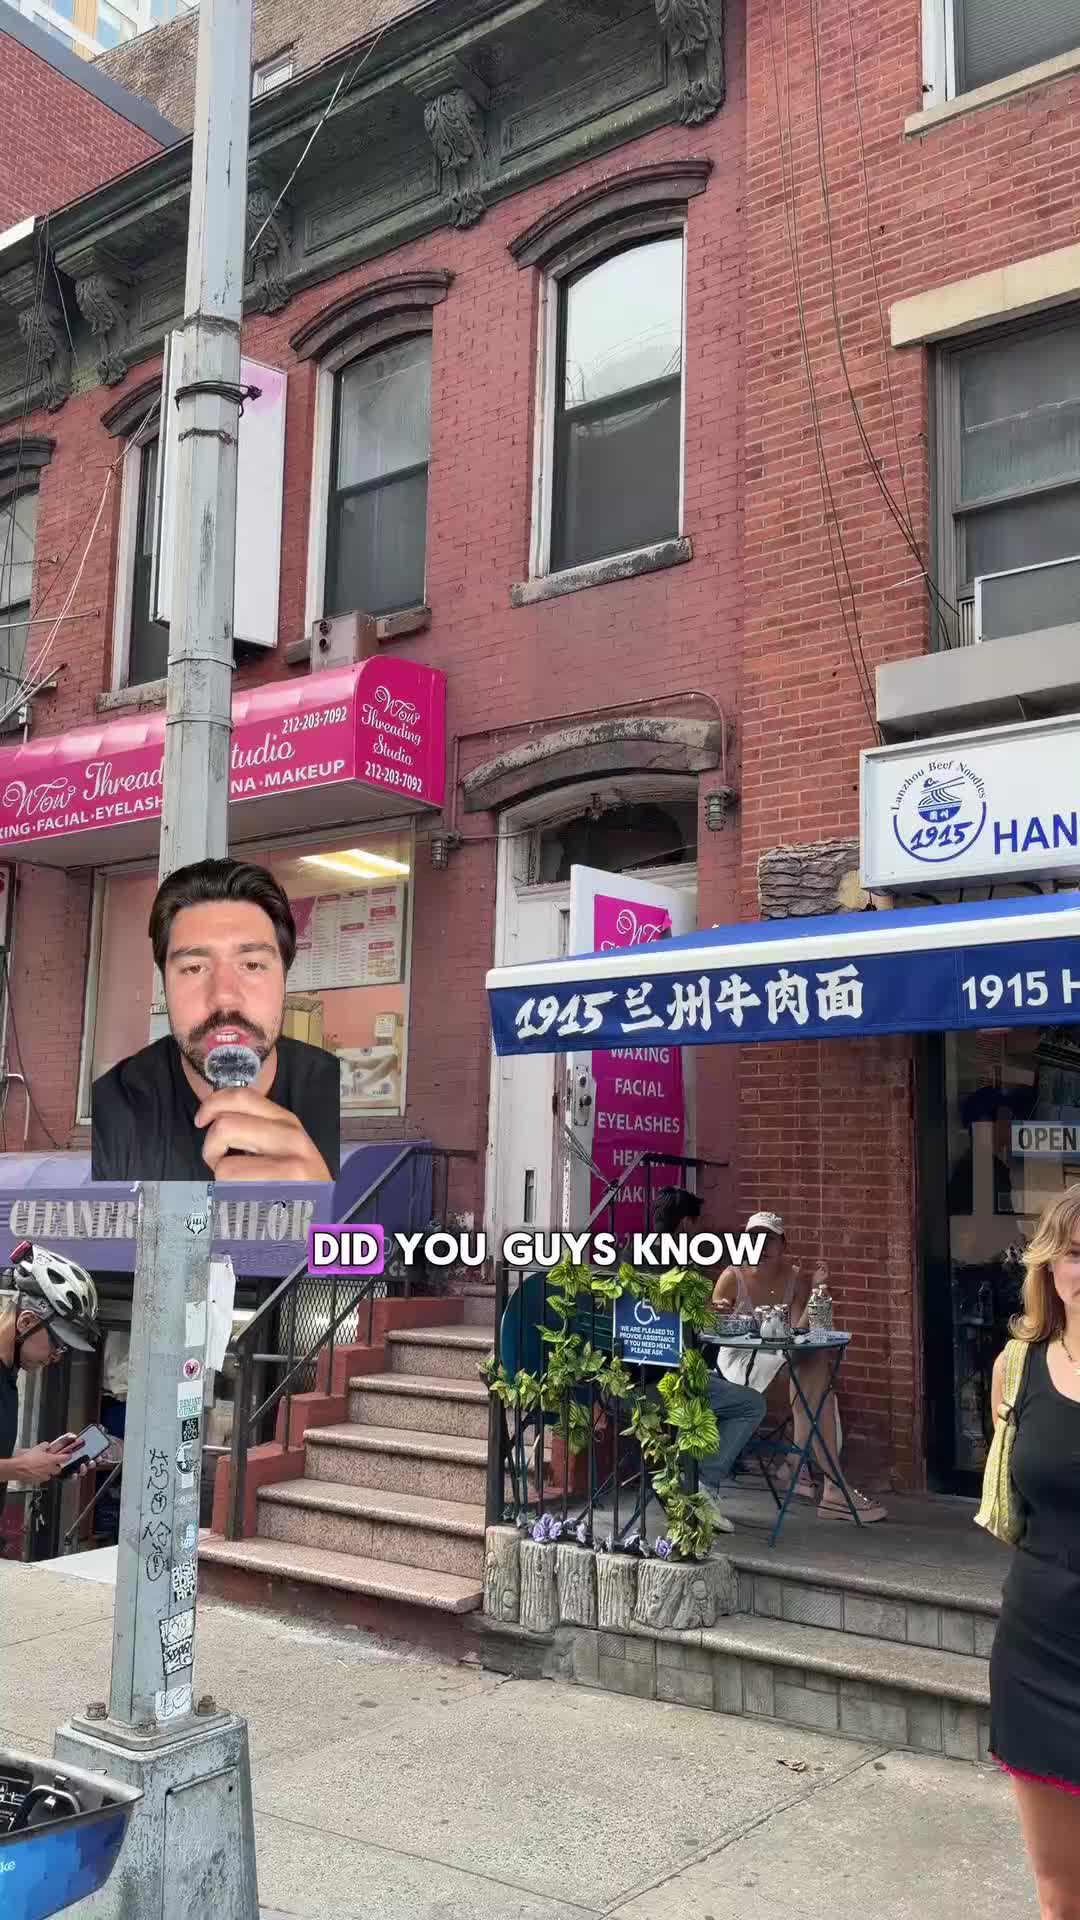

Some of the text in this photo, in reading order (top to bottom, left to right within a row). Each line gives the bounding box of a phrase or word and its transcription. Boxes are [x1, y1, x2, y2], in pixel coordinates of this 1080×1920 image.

[282, 705, 347, 734] 212-203-7092
[375, 686, 420, 725] Wow
[361, 704, 422, 746] Threading
[373, 734, 414, 766] Studio
[3, 732, 296, 818] Wow Thread tudio
[365, 761, 422, 792] 212-203-7092
[891, 760, 986, 811] Lanzhou Beef Noodles
[910, 821, 975, 851] 1915
[993, 811, 1078, 855] HAN
[515, 963, 864, 1039] 1915 兰州牛肉面
[961, 970, 1048, 1011] 1915
[615, 1078, 664, 1098] FACIAL
[598, 1111, 680, 1133] EYELASHES
[1018, 1127, 1077, 1151] OPEN
[212, 1199, 314, 1240] AILOR
[620, 1332, 675, 1343] PROVIDE ASSISTANCE
[642, 1327, 666, 1335] PLEASED
[630, 1347, 651, 1355] PLEASE
